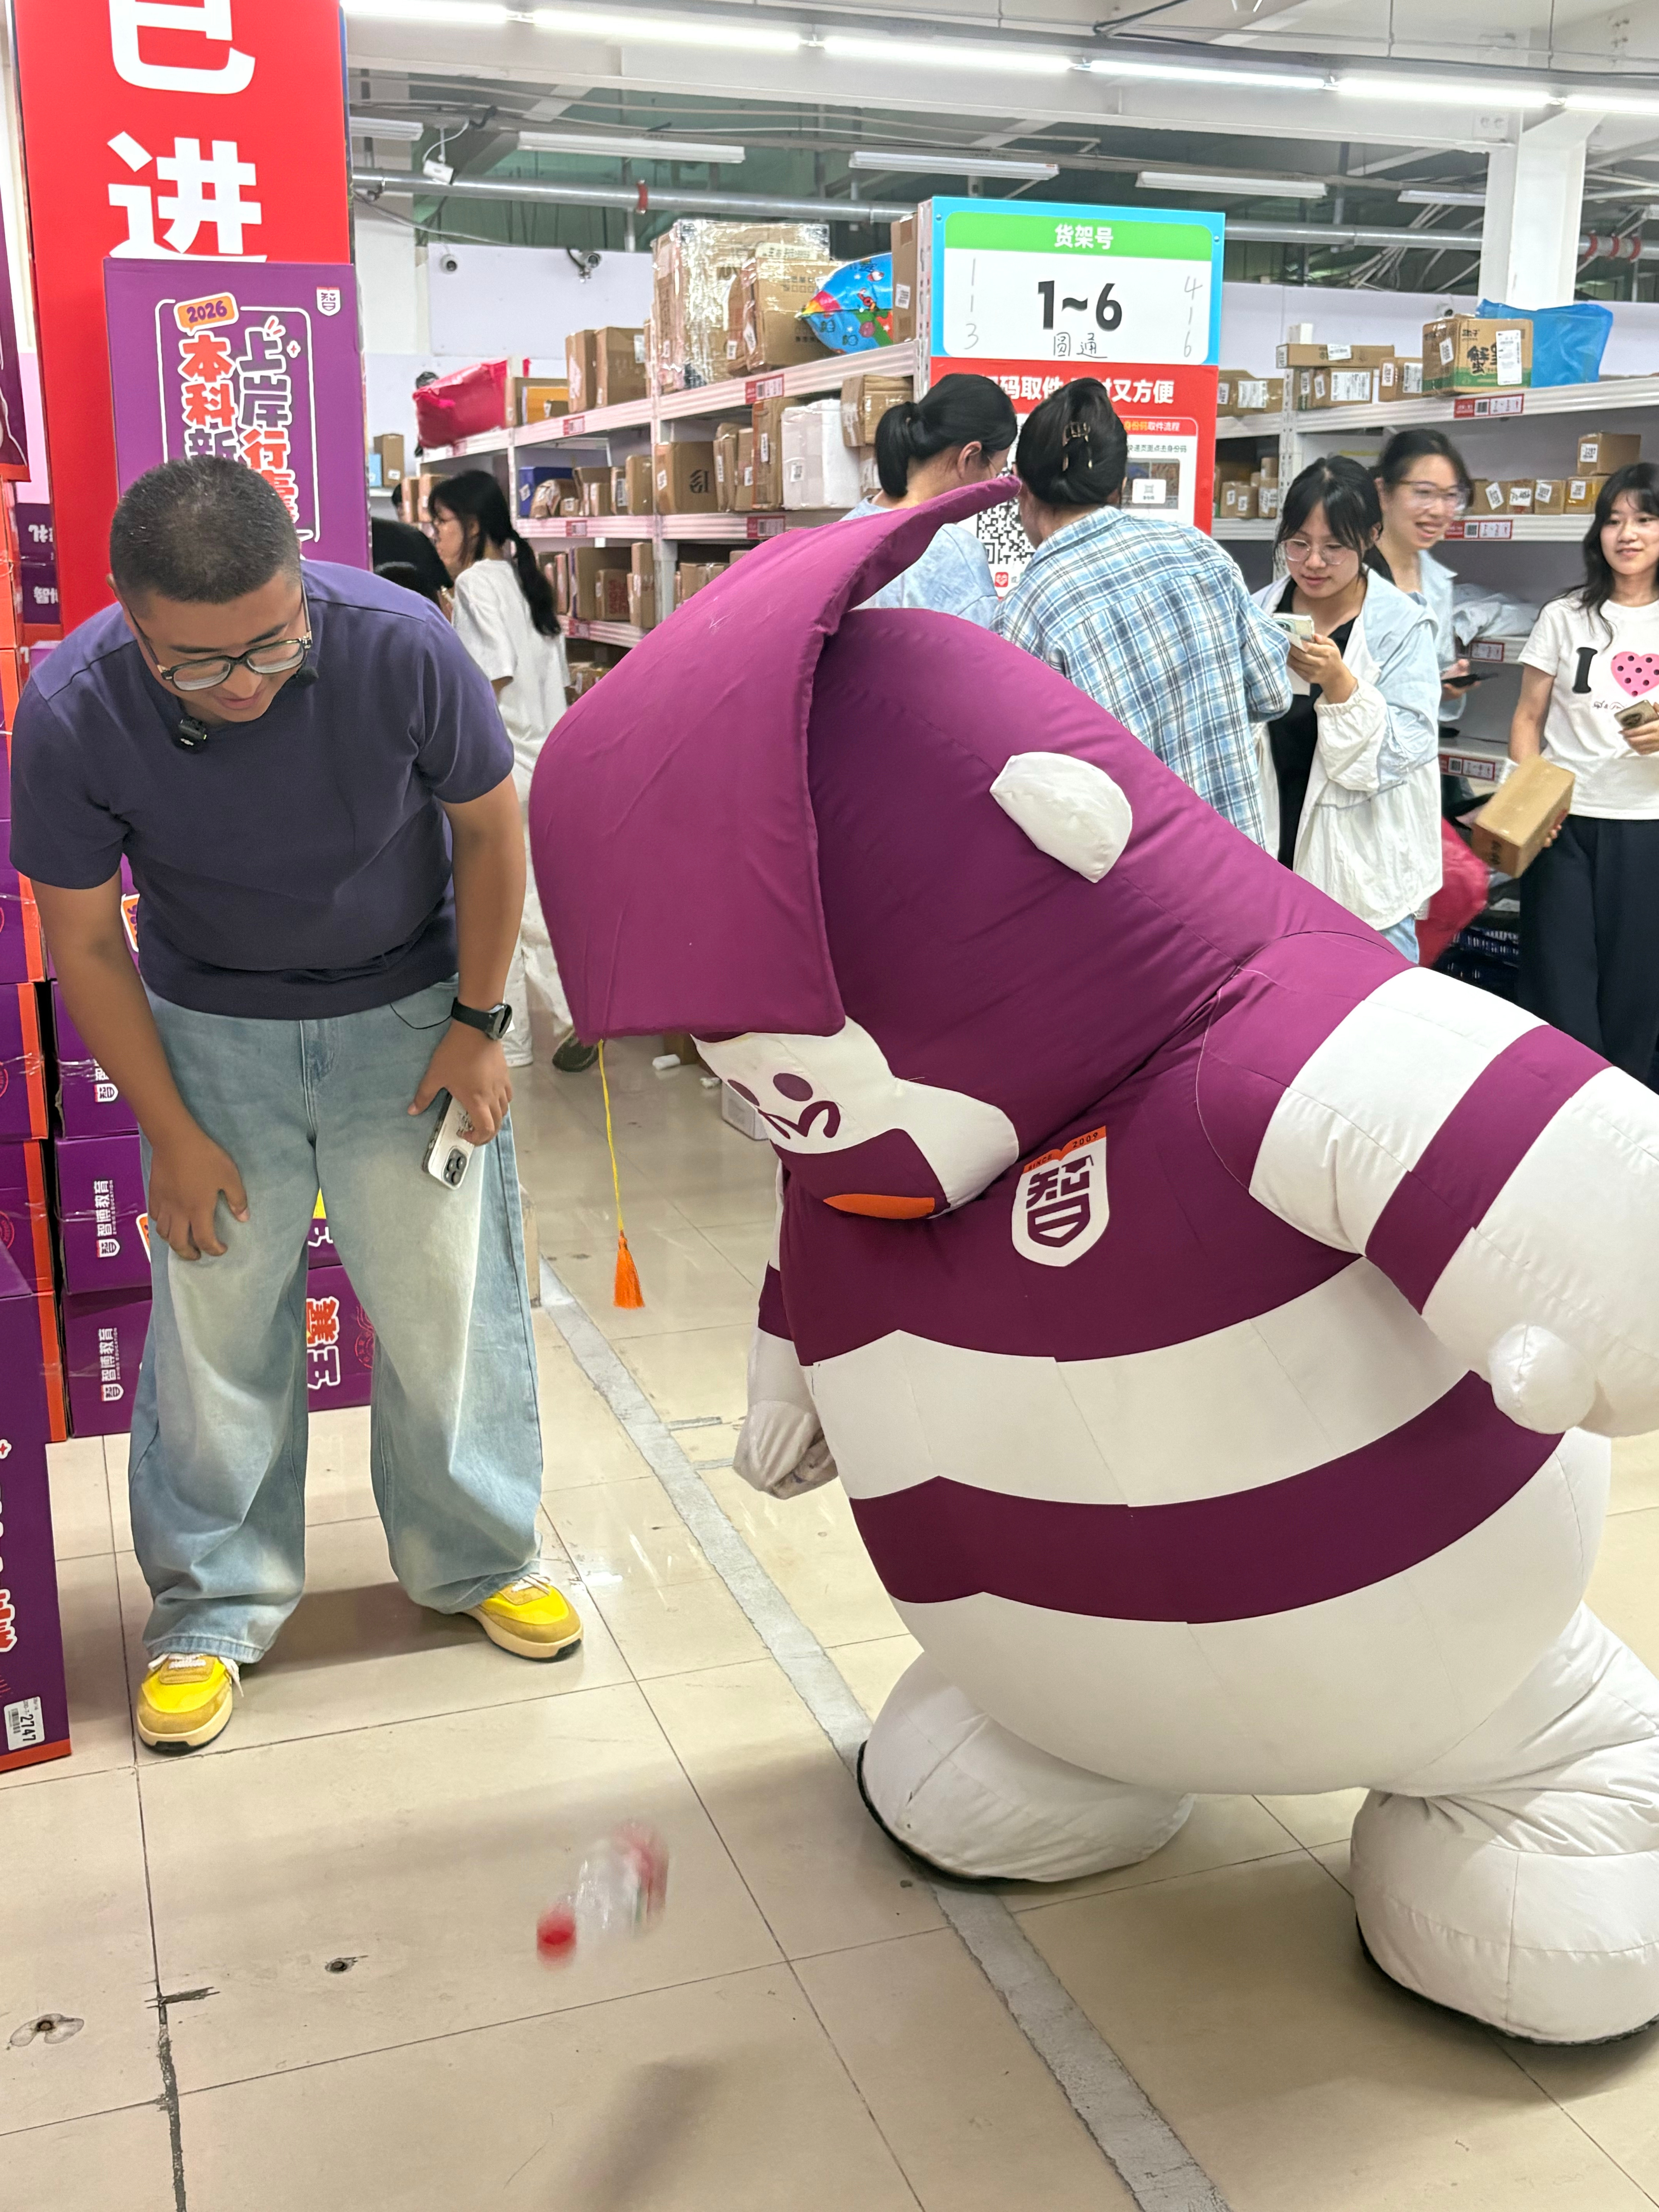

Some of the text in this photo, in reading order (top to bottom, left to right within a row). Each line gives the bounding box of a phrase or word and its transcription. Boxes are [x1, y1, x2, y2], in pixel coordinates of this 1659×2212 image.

[1054, 223, 1114, 250] 货架号
[187, 300, 228, 323] 2026
[987, 376, 1064, 400] 码取件
[1572, 647, 1598, 694] I
[1028, 1132, 1098, 1171] SINCE 2009
[94, 1180, 112, 1237] 智博教育
[99, 1328, 117, 1382] 智博教育
[20, 1714, 36, 1741] 2747
